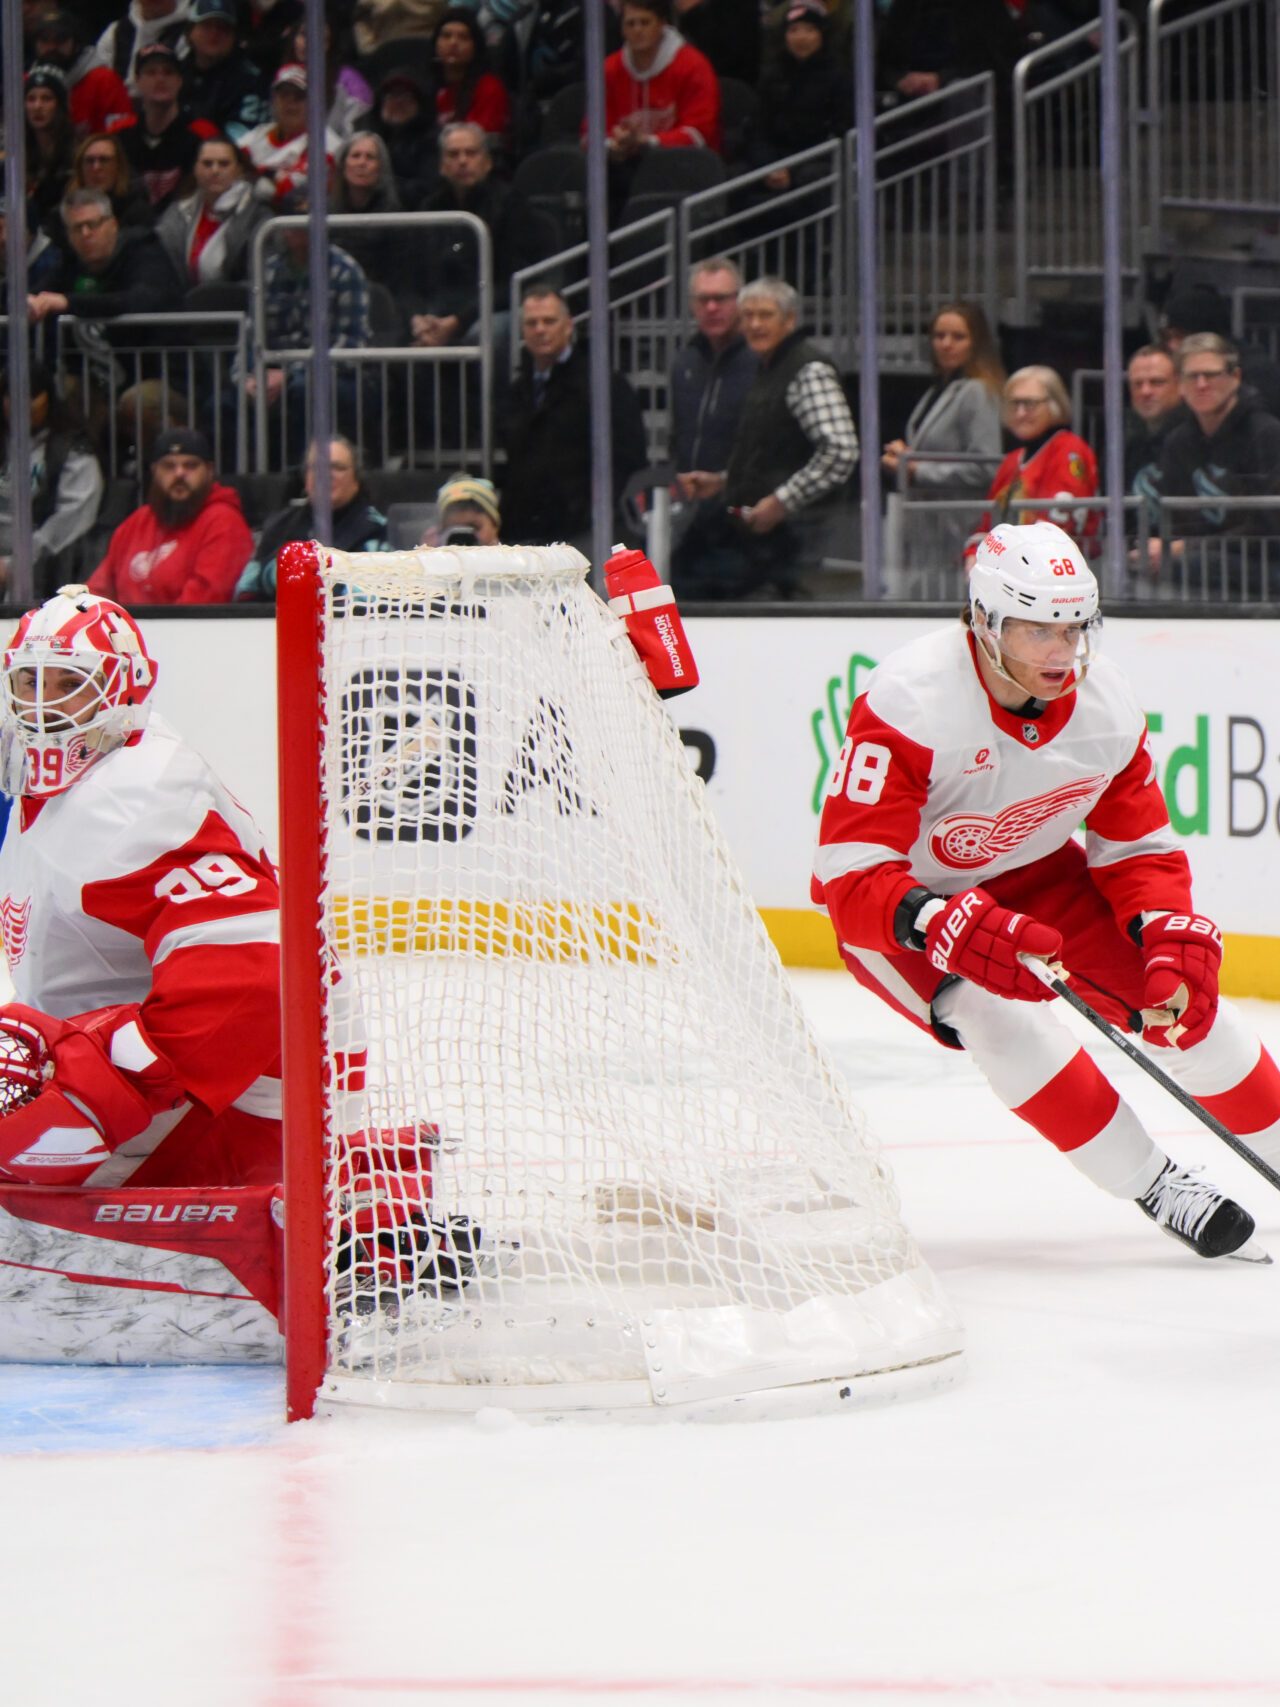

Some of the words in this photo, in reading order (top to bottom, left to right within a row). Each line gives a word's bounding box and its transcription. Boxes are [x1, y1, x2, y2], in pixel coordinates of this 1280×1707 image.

[654, 614, 684, 678] BODYARMOR
[931, 892, 983, 974] AUER
[95, 1204, 239, 1222] BAUER
